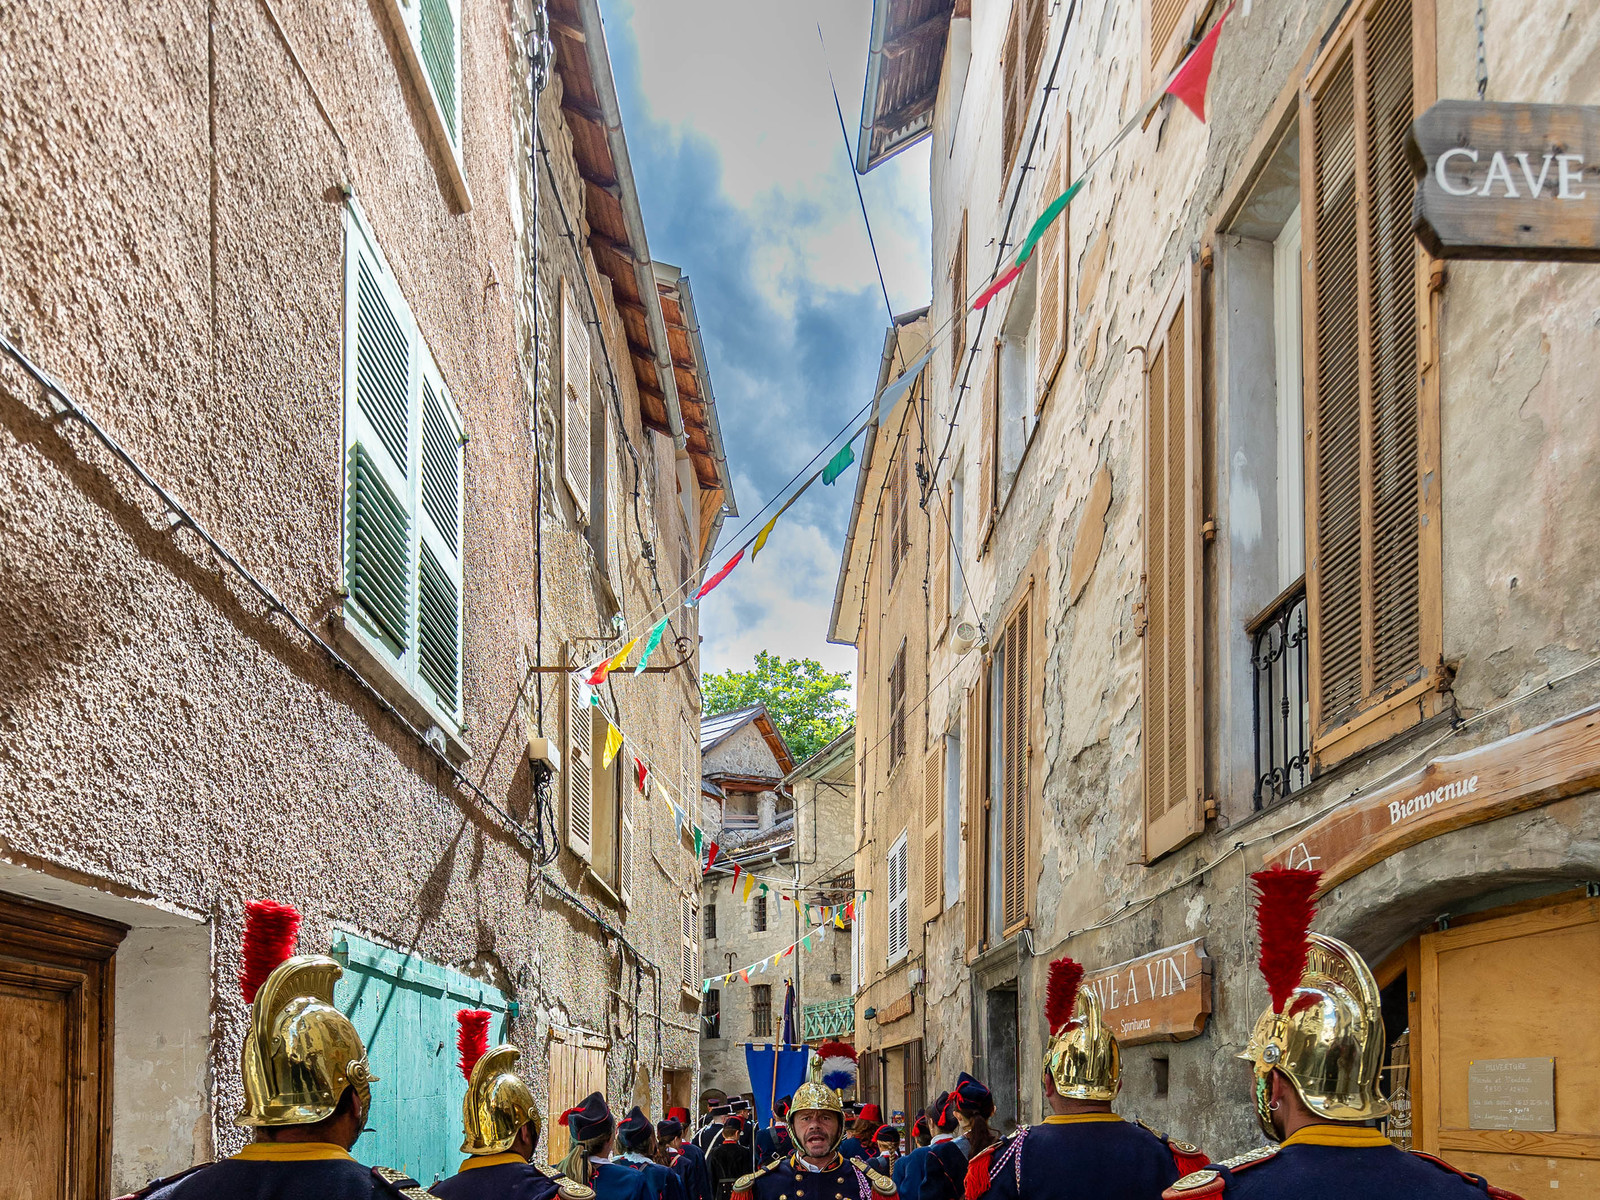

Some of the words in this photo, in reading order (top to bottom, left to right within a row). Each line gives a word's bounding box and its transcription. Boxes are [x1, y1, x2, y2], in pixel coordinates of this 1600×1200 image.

[1435, 148, 1586, 199] CAVE
[1387, 775, 1479, 825] Bienvenue
[1092, 974, 1120, 1011] VE
[1125, 969, 1139, 1006] A
[1146, 951, 1187, 1000] VIN
[1120, 1018, 1151, 1037] Spiritueux
